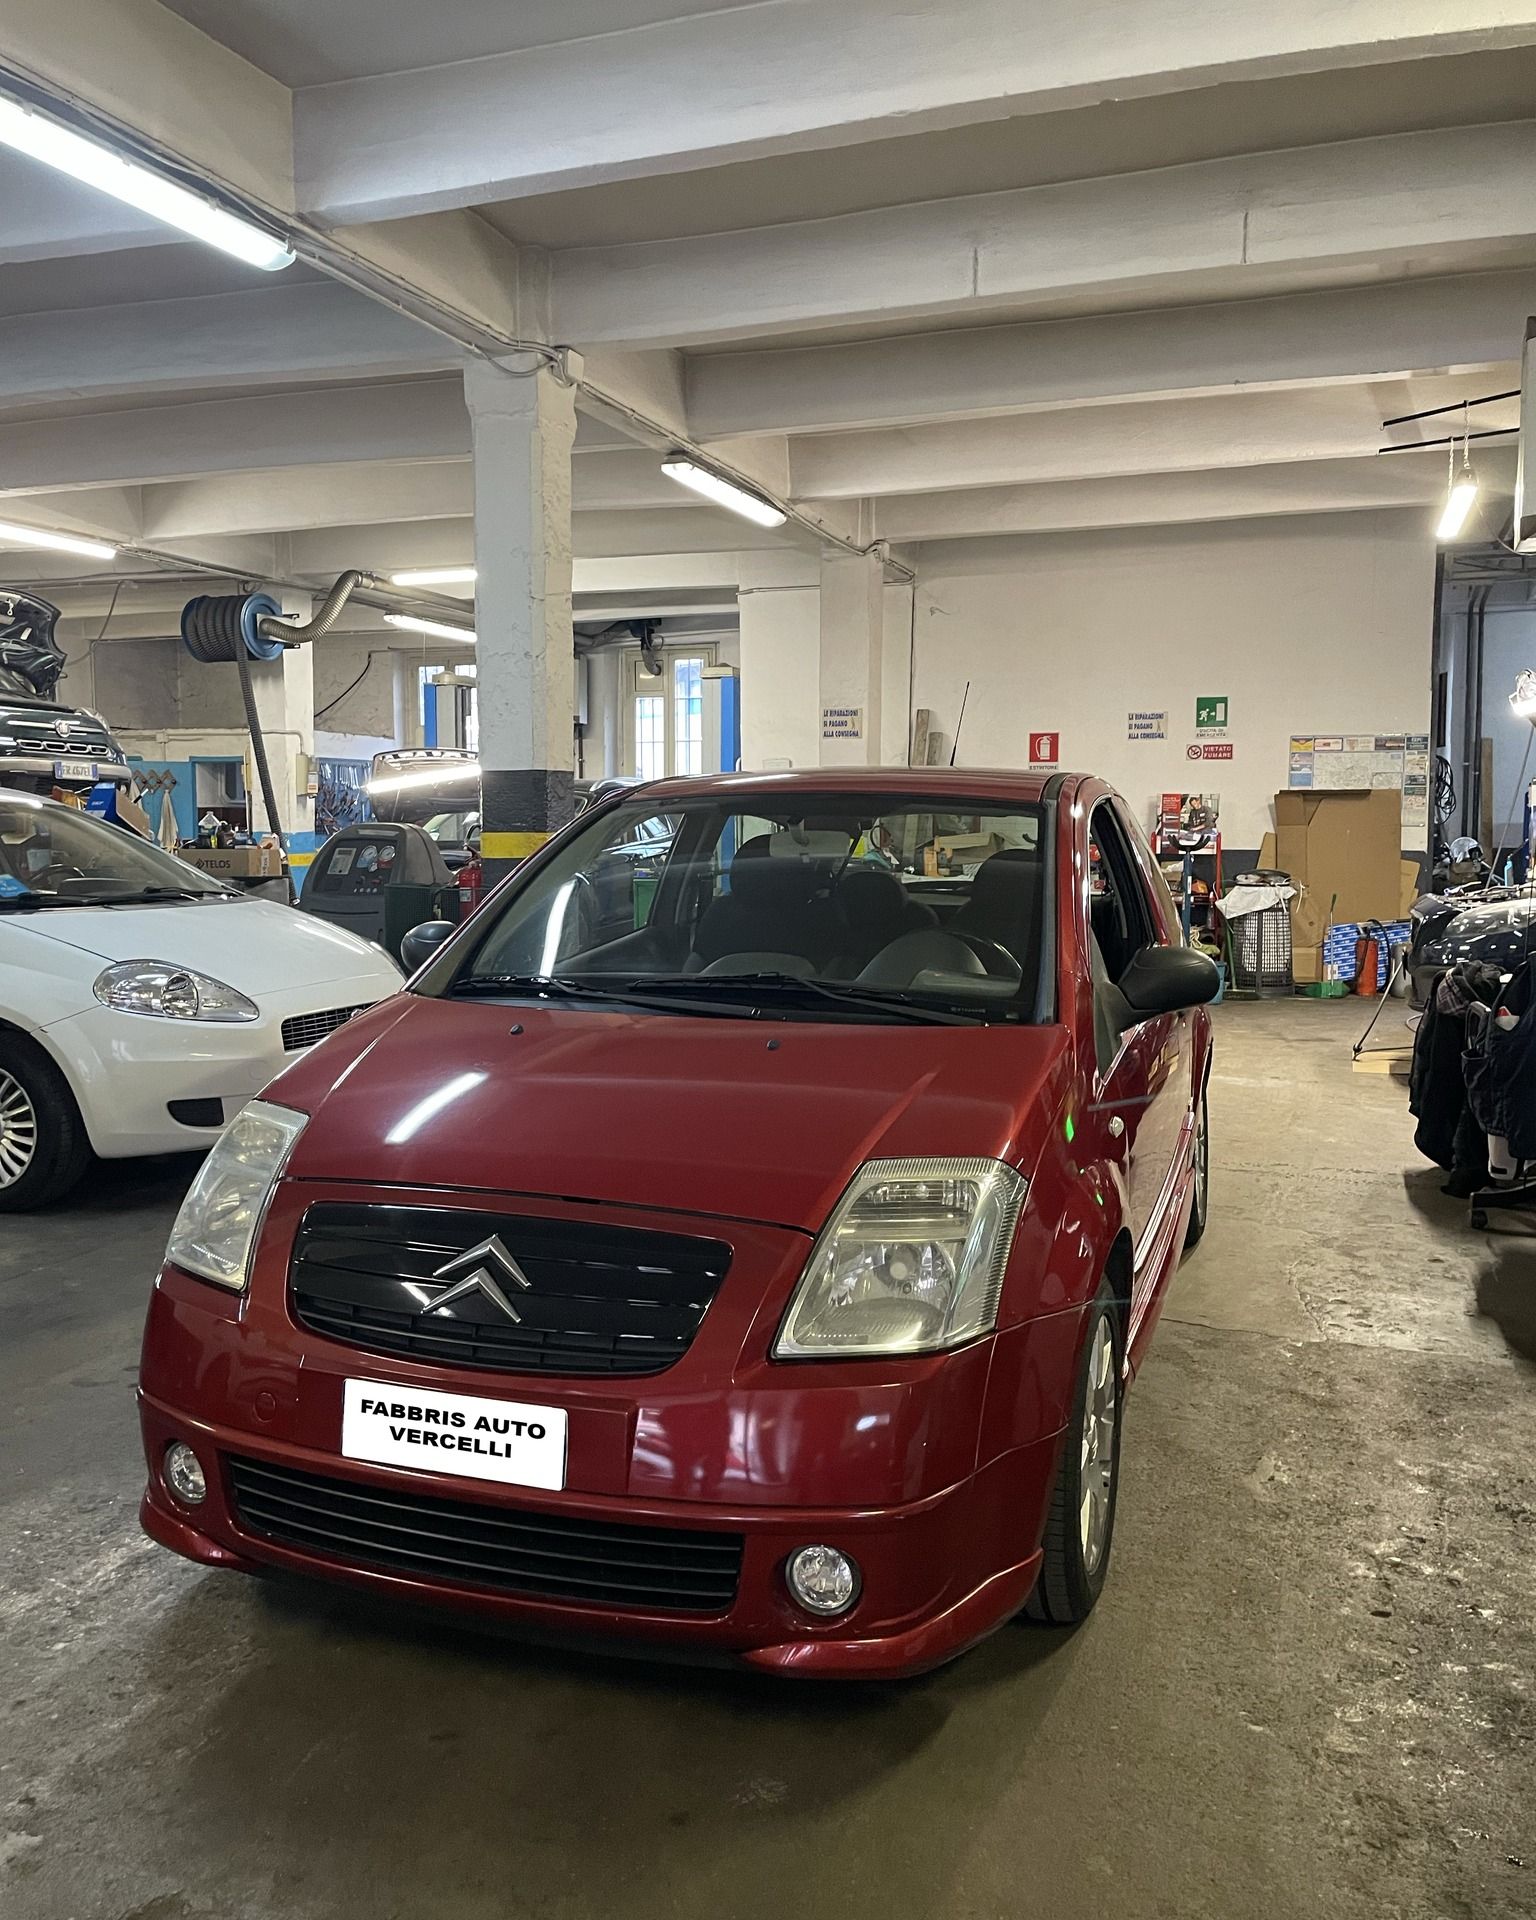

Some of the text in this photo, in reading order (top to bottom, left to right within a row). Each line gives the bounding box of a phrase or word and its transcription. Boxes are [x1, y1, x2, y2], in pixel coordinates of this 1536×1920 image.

[830, 709, 859, 717] RIPARAZIONI
[835, 730, 859, 738] CONSEGNA
[205, 860, 231, 869] TELOS
